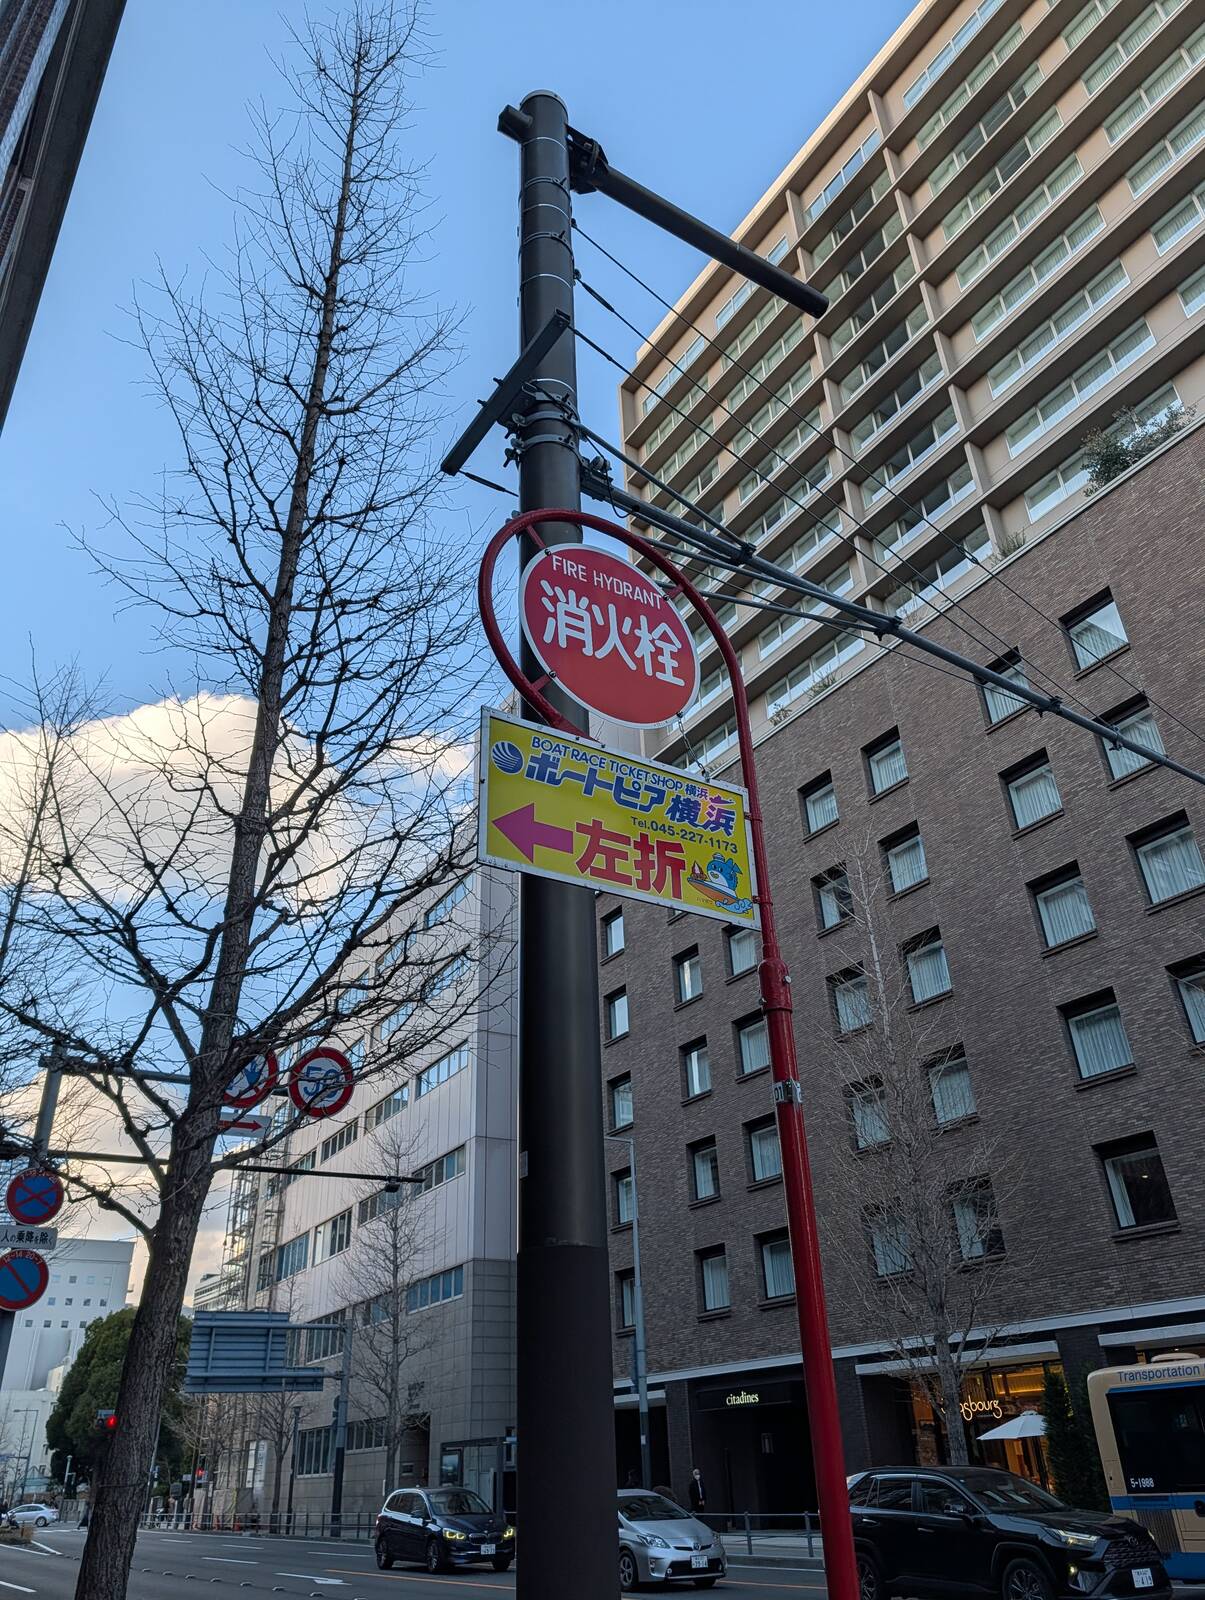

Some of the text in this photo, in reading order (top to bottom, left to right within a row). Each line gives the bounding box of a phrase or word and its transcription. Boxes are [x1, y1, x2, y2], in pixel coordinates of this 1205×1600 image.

[552, 555, 662, 609] FIRE HYDRANT
[540, 580, 685, 686] 消火栓
[685, 783, 709, 800] 横浜
[575, 819, 687, 900] 左折
[1118, 1365, 1200, 1382] Transportation
[726, 1390, 759, 1406] citadines
